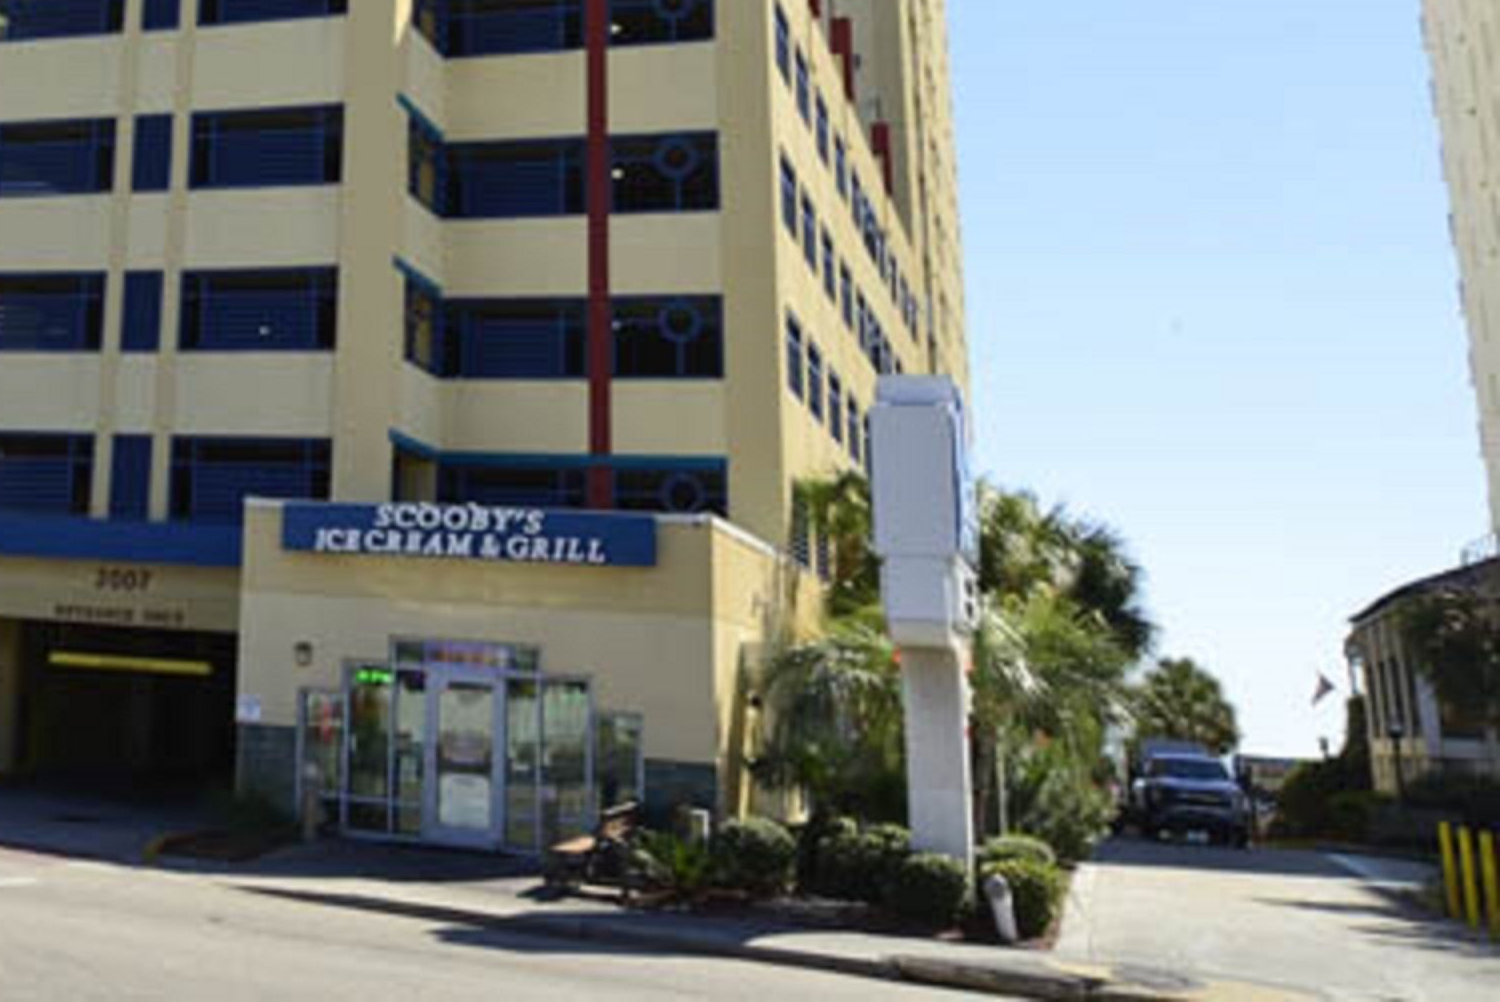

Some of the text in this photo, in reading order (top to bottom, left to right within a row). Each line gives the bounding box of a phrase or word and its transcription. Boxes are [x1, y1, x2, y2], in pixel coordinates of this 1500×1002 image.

[375, 502, 544, 534] SCOOBY'S
[316, 529, 605, 563] ICE CREAM & GRILL
